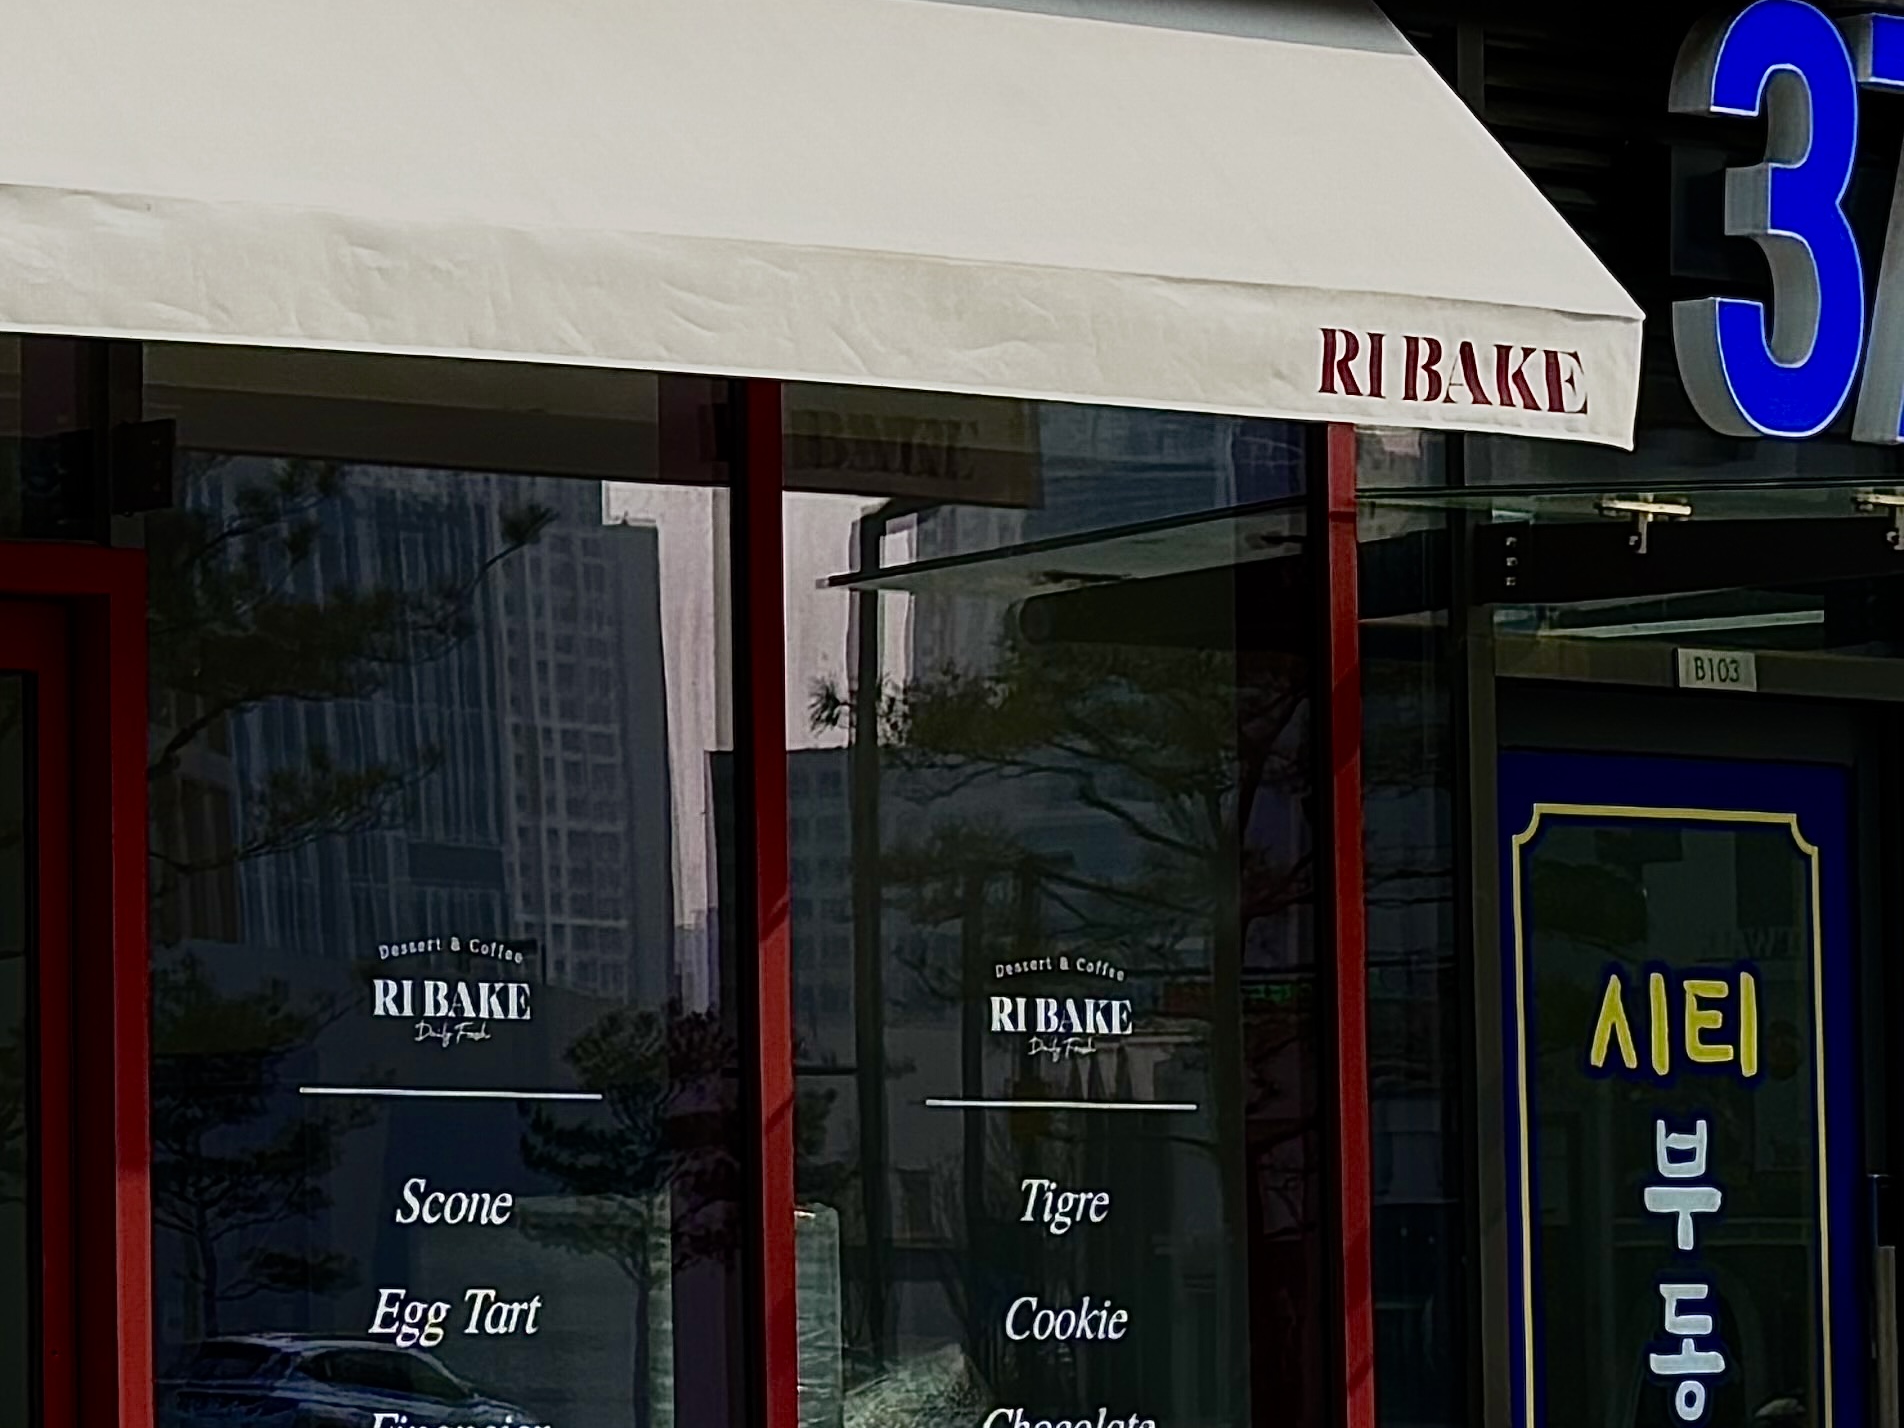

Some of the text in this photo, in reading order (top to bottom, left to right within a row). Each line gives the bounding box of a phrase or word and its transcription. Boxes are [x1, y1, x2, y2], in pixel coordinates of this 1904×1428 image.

[1318, 327, 1588, 415] RI BAKE
[1693, 656, 1741, 684] B103
[378, 938, 441, 960] Dessert
[469, 938, 524, 964] Coffee
[373, 979, 531, 1020] RI BAKE
[990, 996, 1133, 1035] RI BAKE
[1590, 971, 1758, 1078] 시티
[395, 1177, 513, 1225] Scone
[1020, 1179, 1110, 1235] Tigre
[367, 1288, 542, 1348] Egg Tart
[1005, 1296, 1128, 1341] Cookie
